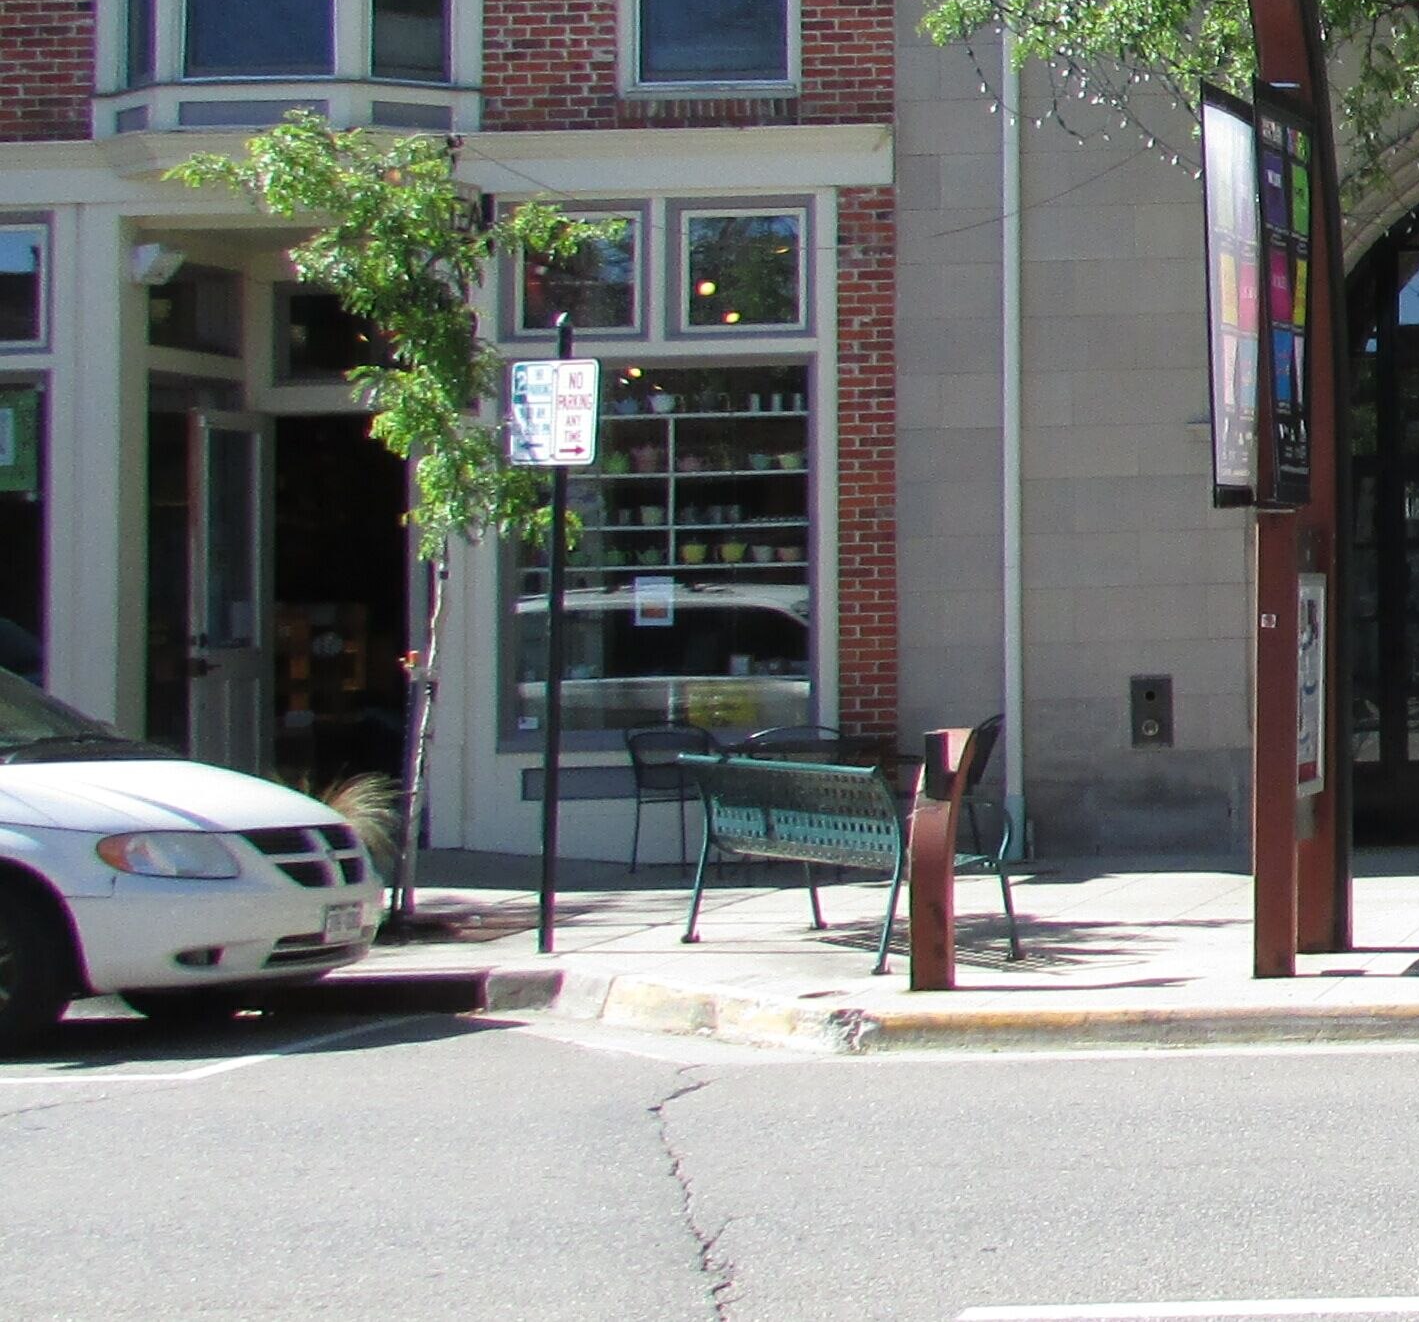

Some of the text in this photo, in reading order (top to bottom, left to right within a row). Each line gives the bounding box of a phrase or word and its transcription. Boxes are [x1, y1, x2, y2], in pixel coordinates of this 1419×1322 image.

[568, 371, 584, 390] NO
[557, 394, 593, 410] PARKING
[566, 414, 582, 427] ANY
[564, 430, 583, 443] TIME
